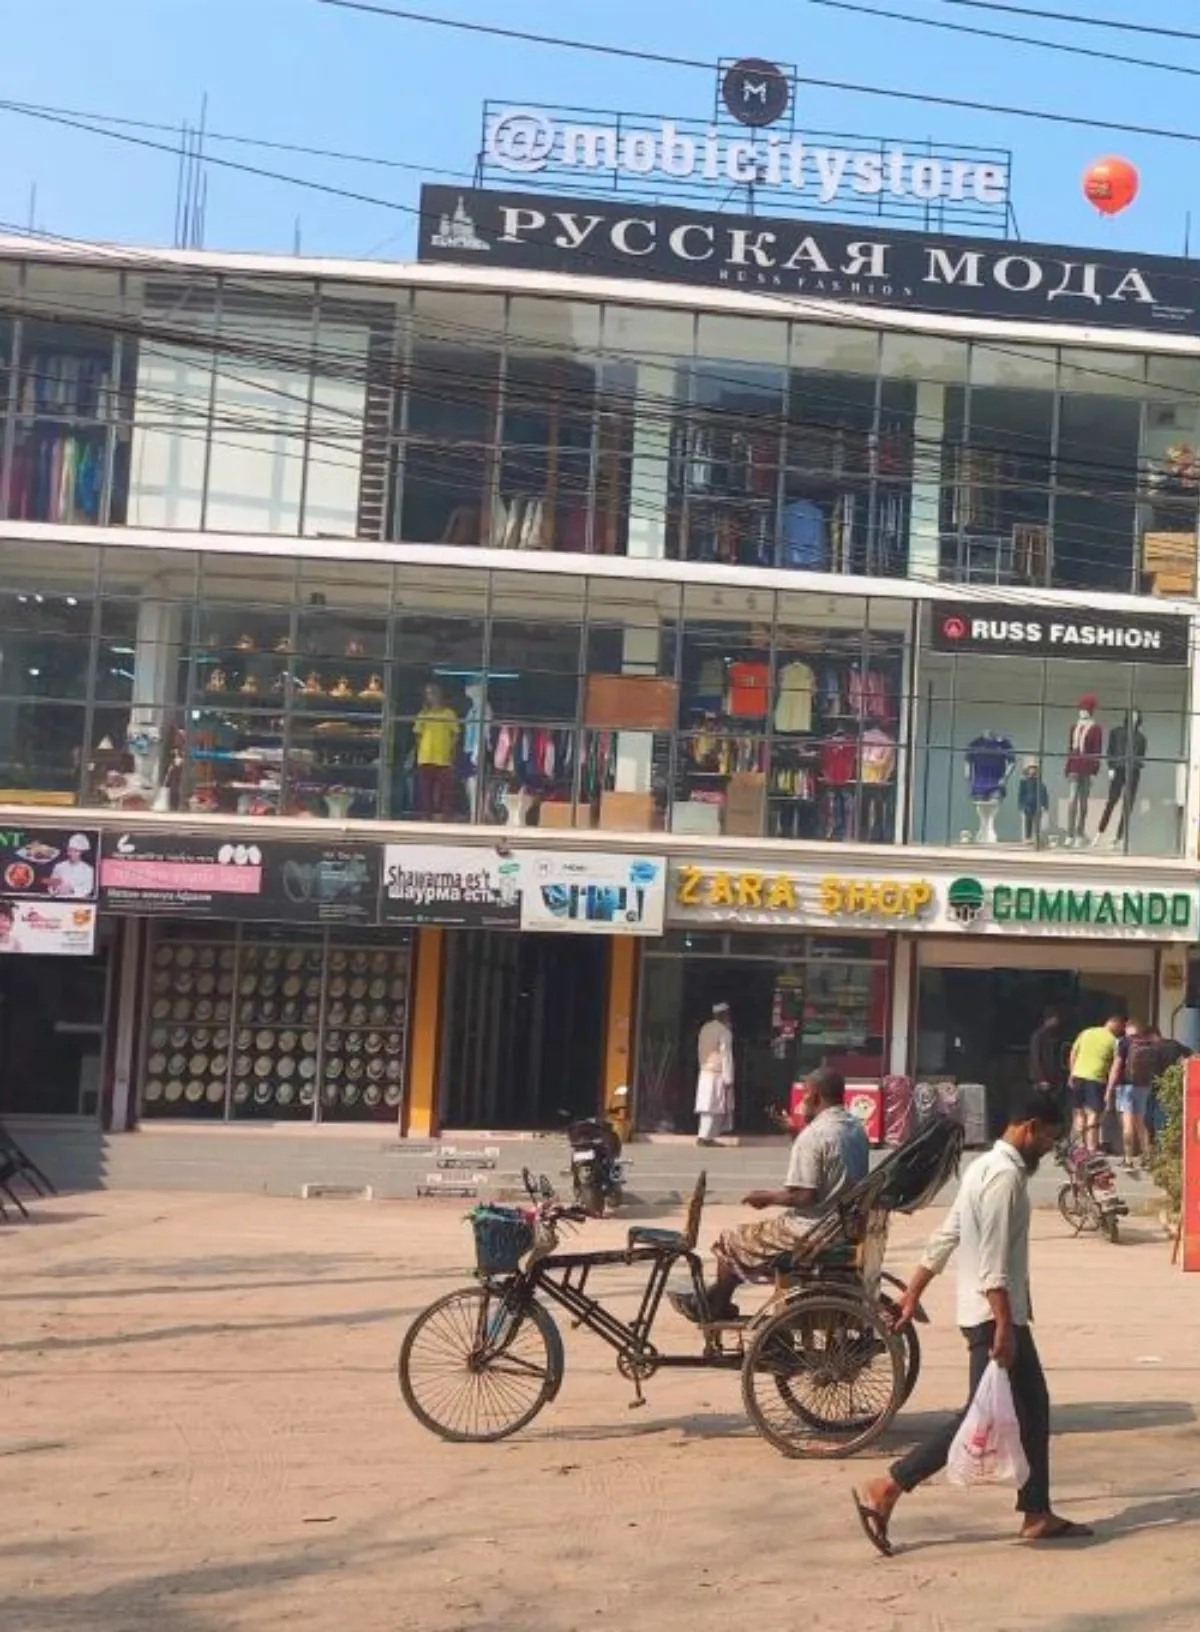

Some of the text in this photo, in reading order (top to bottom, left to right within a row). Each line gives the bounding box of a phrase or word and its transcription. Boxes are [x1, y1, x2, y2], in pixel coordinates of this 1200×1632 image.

[486, 112, 1006, 203] @mobicitystore
[496, 205, 1160, 306] РУССКАЯ МОДА
[971, 619, 1161, 649] RUSS FASHION
[388, 863, 462, 888] Shawarma
[679, 865, 934, 918] ZARA SHOP
[993, 884, 1192, 928] COMMANDO
